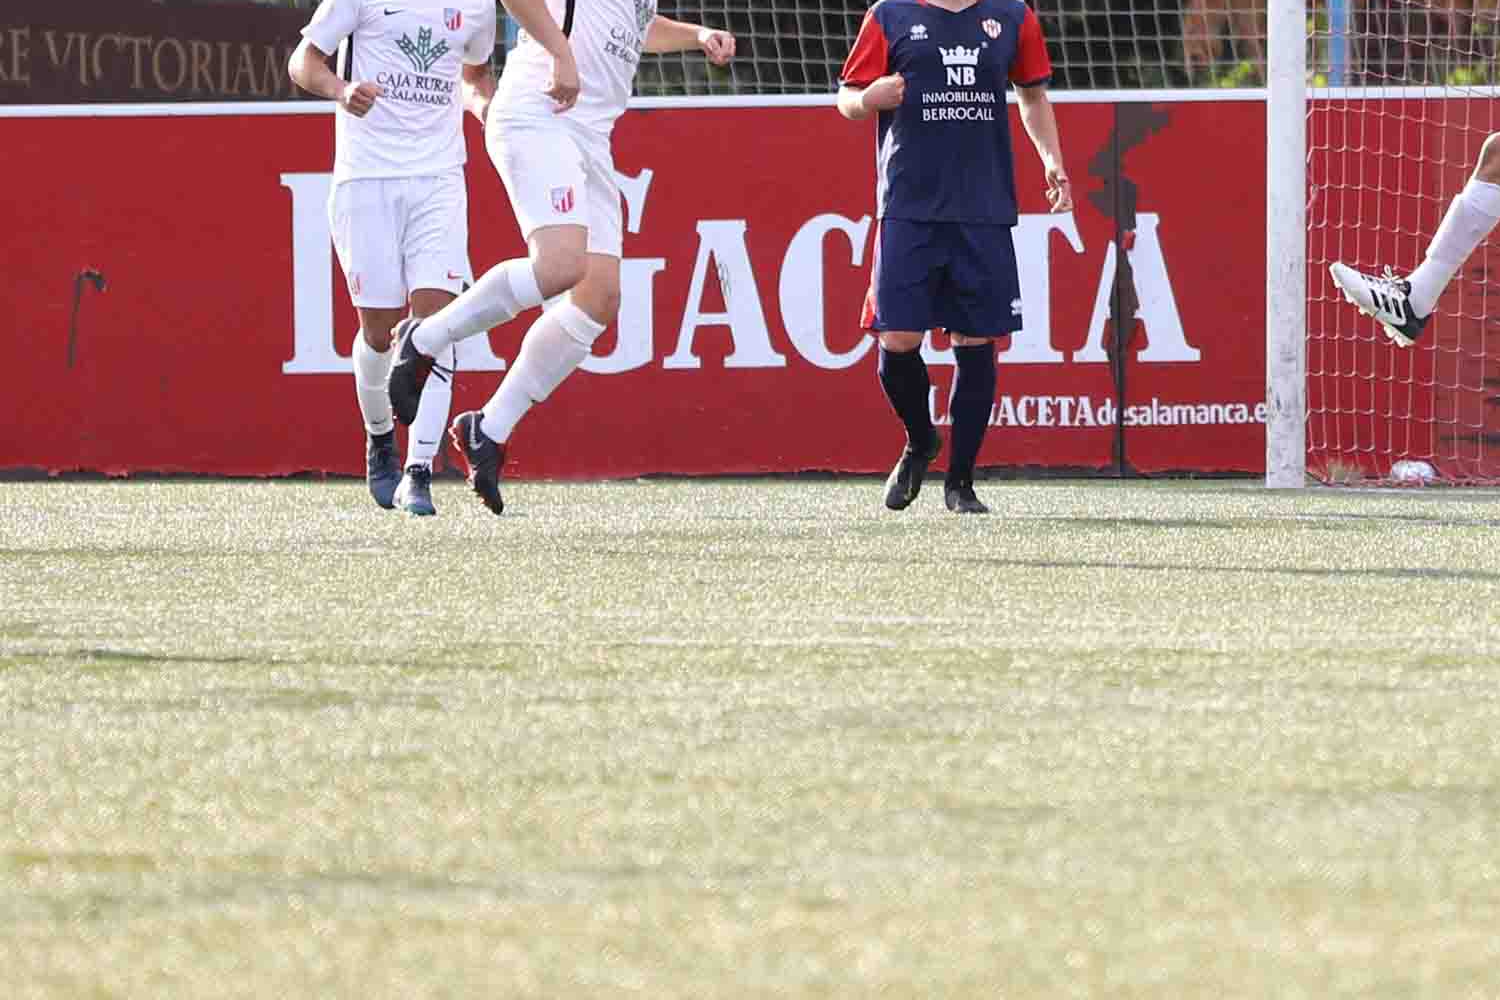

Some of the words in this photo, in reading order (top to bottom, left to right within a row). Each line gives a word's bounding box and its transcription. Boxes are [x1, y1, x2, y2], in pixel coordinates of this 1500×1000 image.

[376, 71, 411, 88] CAJA
[946, 66, 976, 86] NB
[922, 91, 997, 104] INMOBILIARIA
[922, 106, 995, 121] BERROCALL
